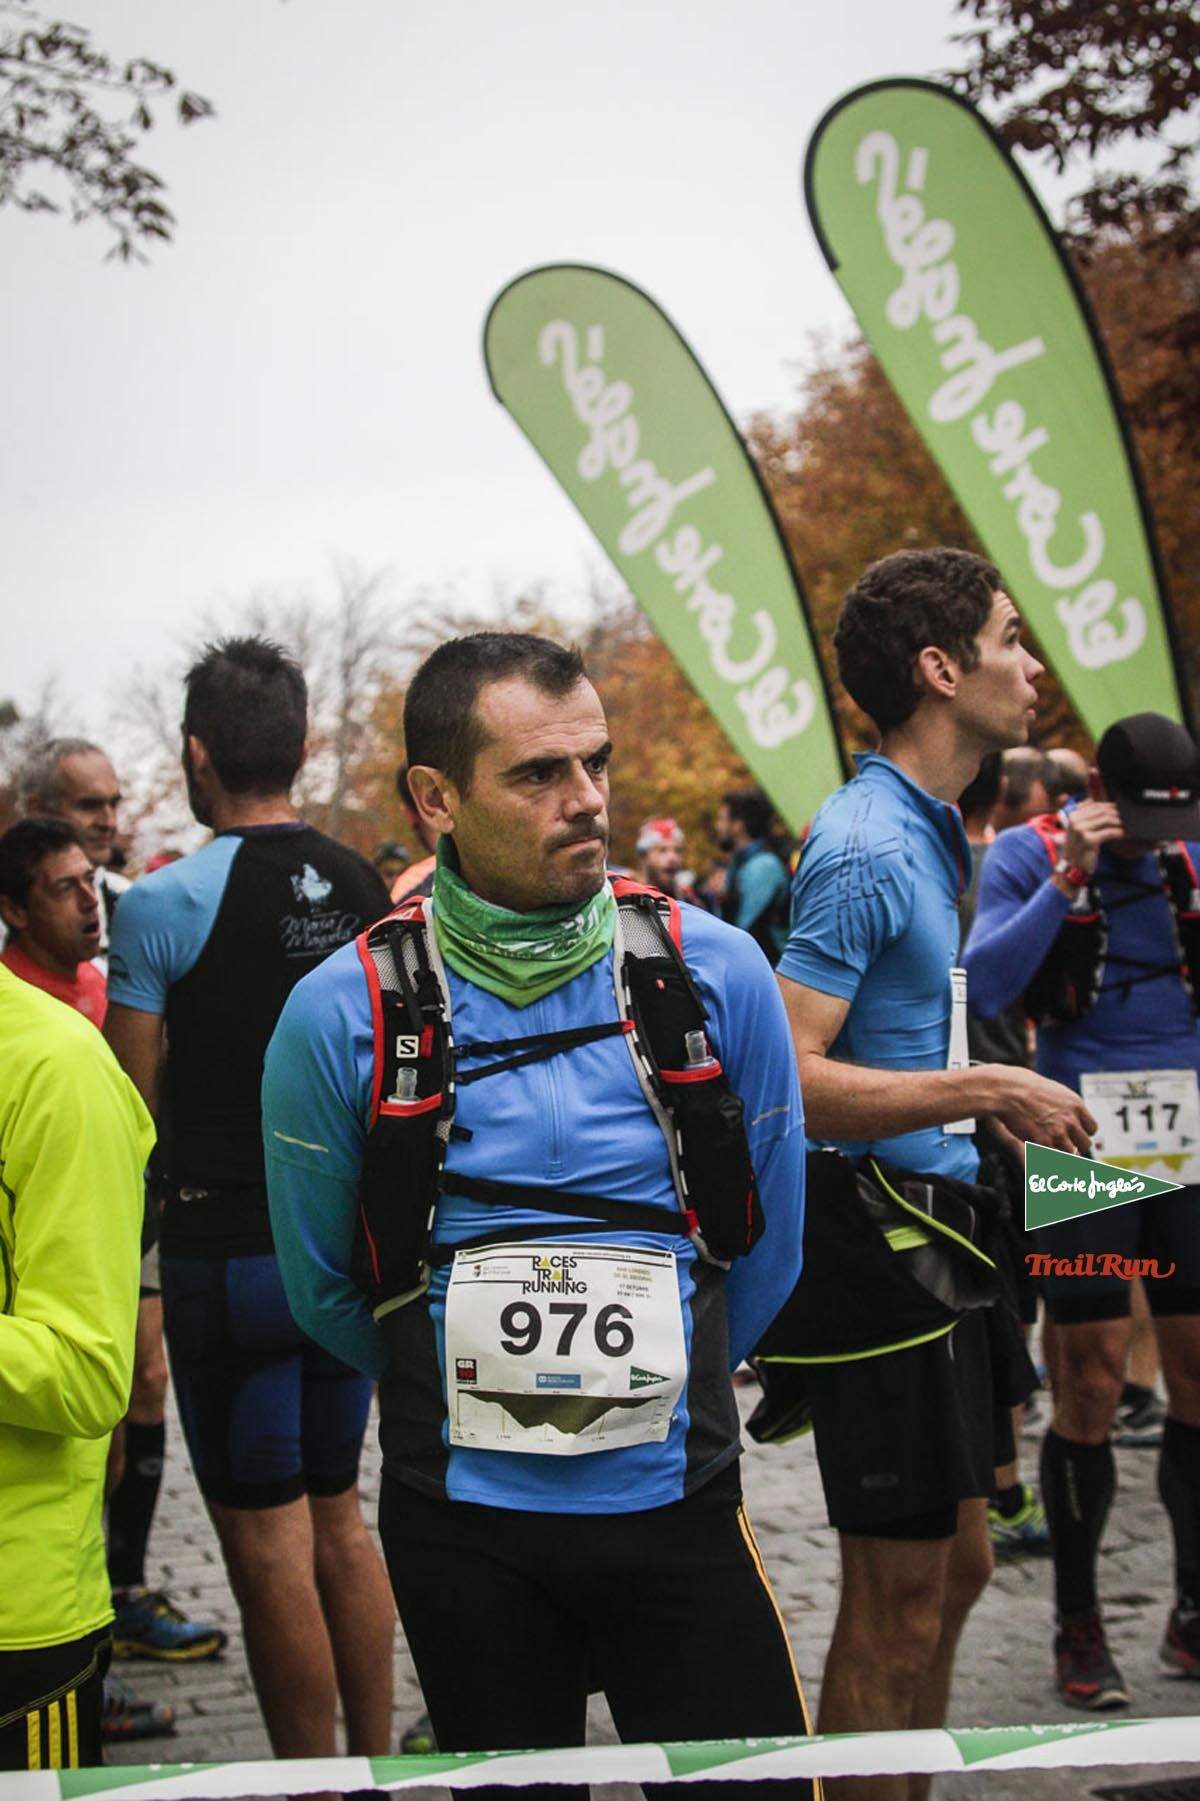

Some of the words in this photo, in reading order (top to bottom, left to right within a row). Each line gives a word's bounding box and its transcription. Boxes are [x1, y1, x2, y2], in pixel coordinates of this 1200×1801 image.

[1115, 1103, 1180, 1131] 117
[523, 1281, 587, 1295] RUNNING
[500, 1301, 634, 1357] 976
